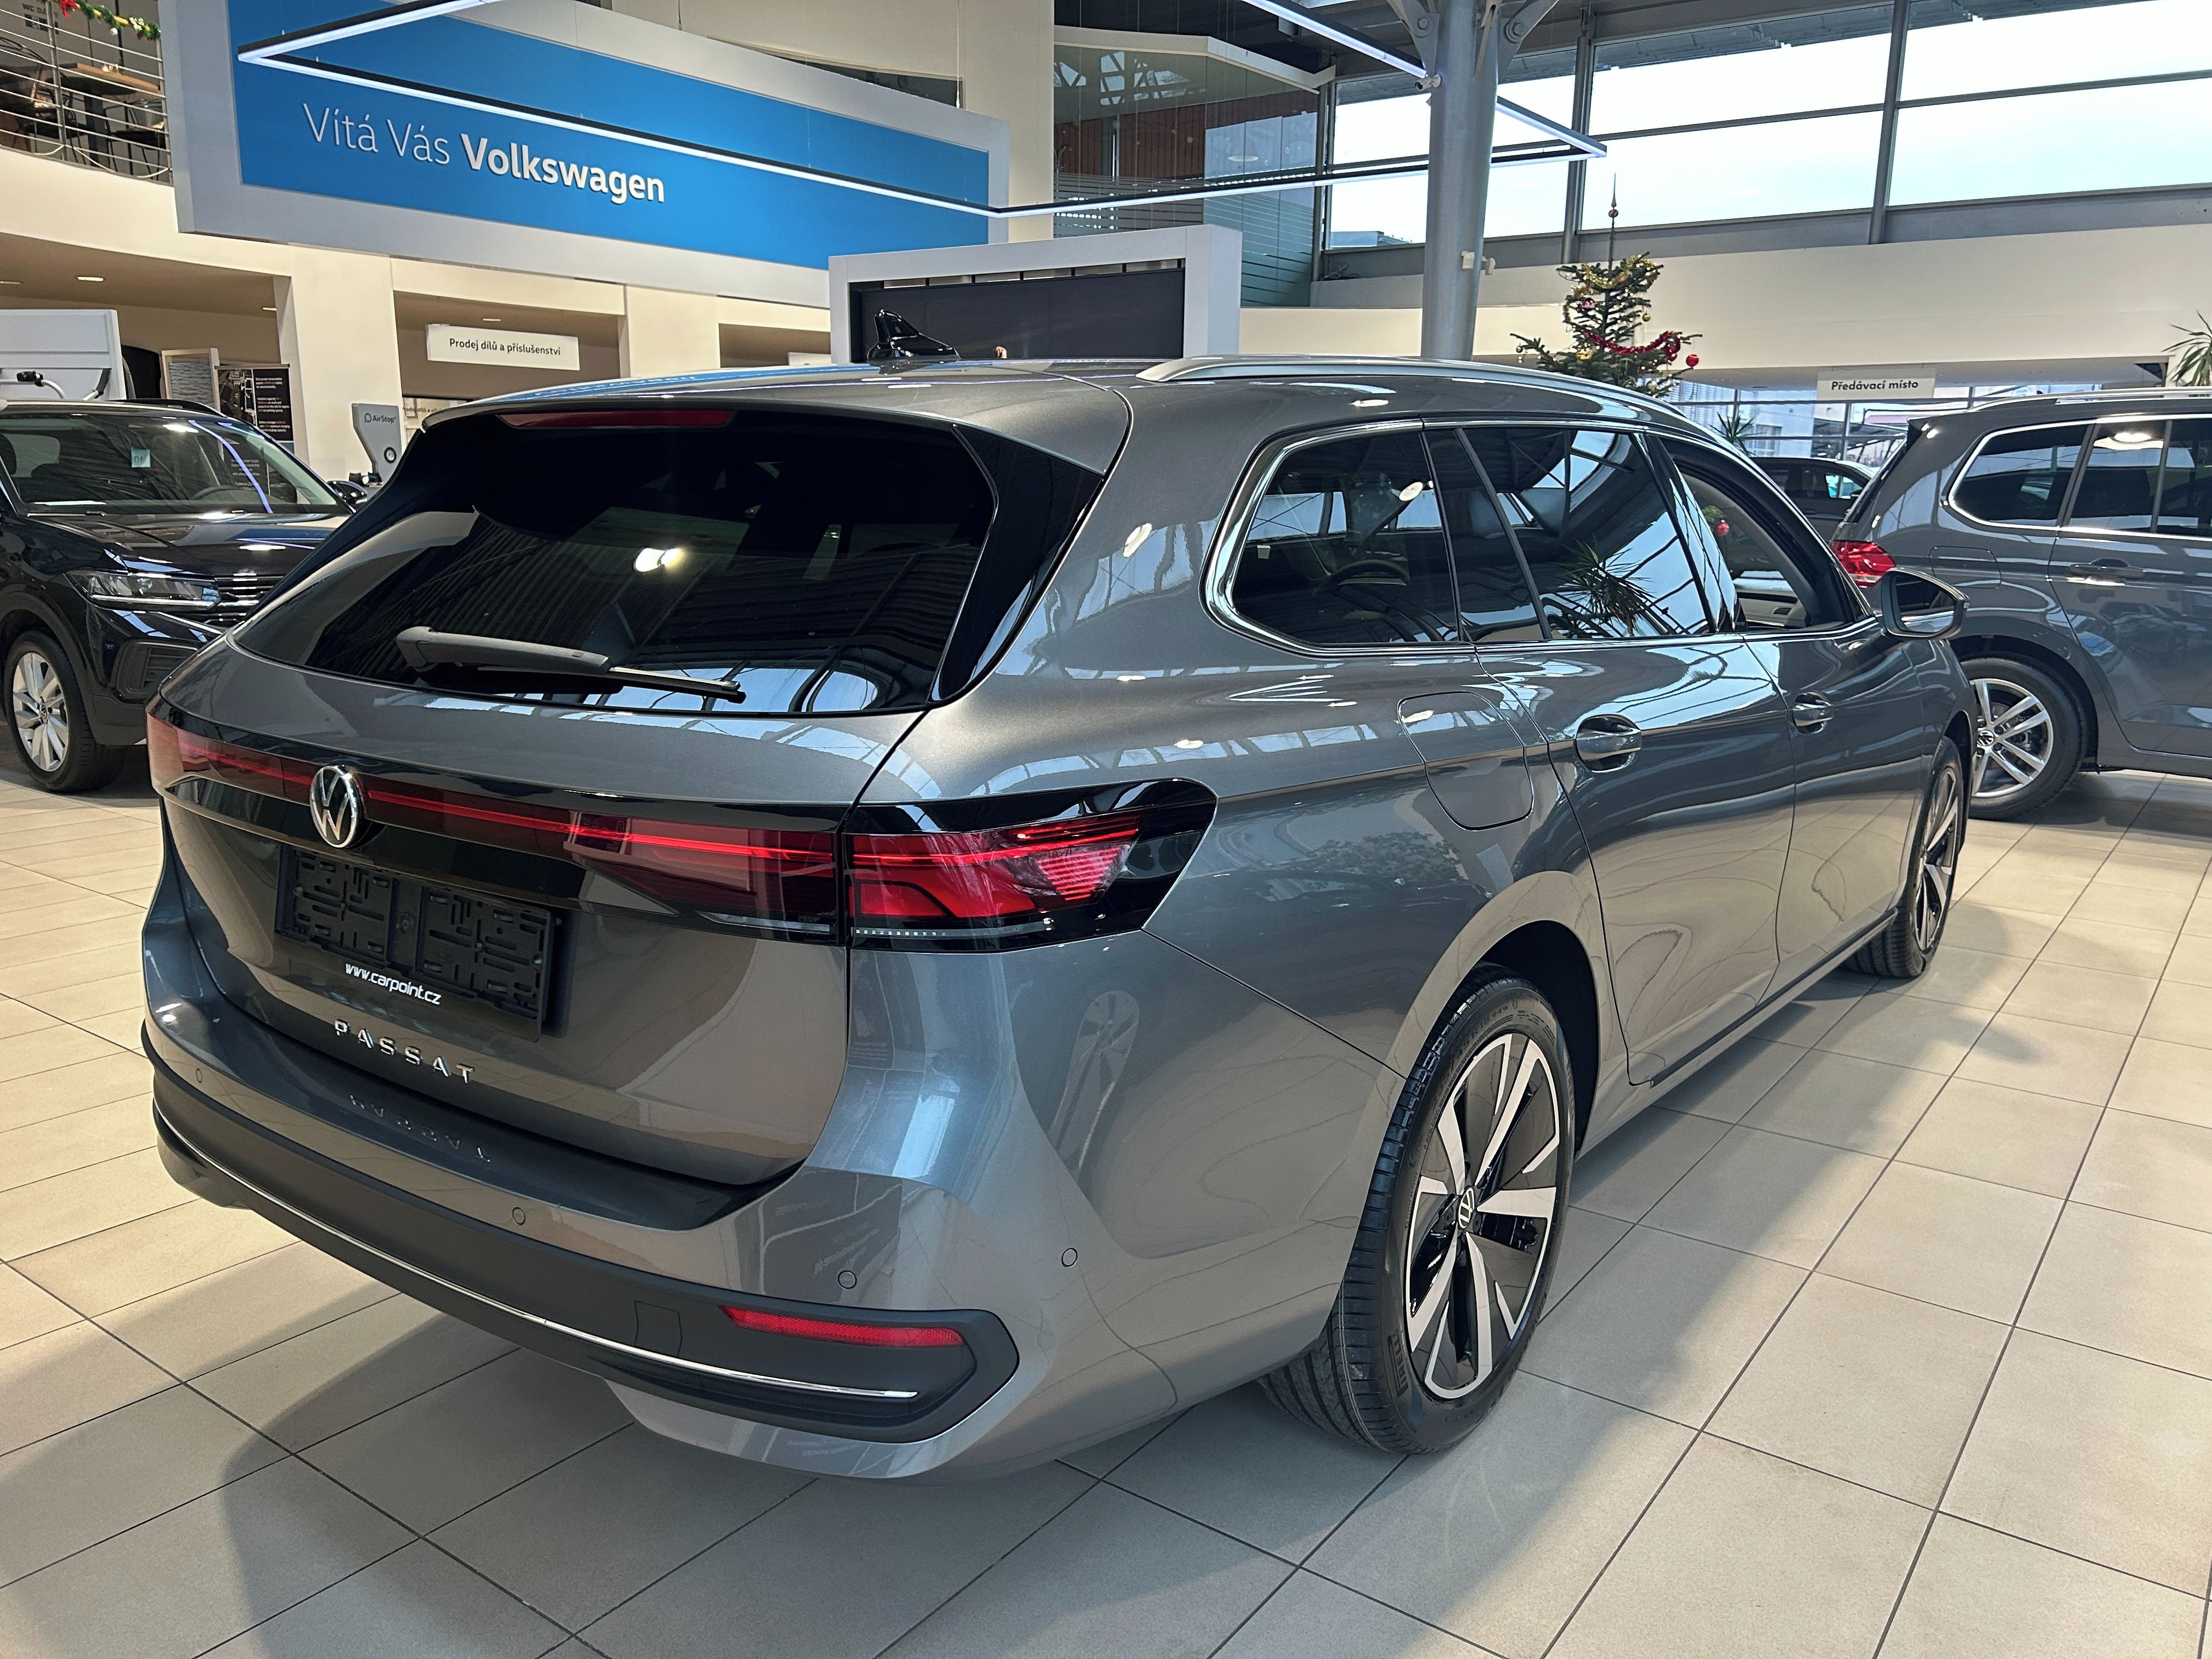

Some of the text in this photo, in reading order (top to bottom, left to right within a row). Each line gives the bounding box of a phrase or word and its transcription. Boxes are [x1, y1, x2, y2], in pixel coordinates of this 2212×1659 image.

[22, 3, 35, 12] WC
[303, 103, 665, 205] Vítá Vás Volkswagen
[449, 338, 478, 351] Prodej
[481, 341, 497, 351] dílů
[507, 343, 561, 356] příslušenství
[1831, 380, 1918, 390] Předávací místo
[345, 963, 442, 1005] www.carpoint.cz
[334, 1019, 475, 1084] PASSAT
